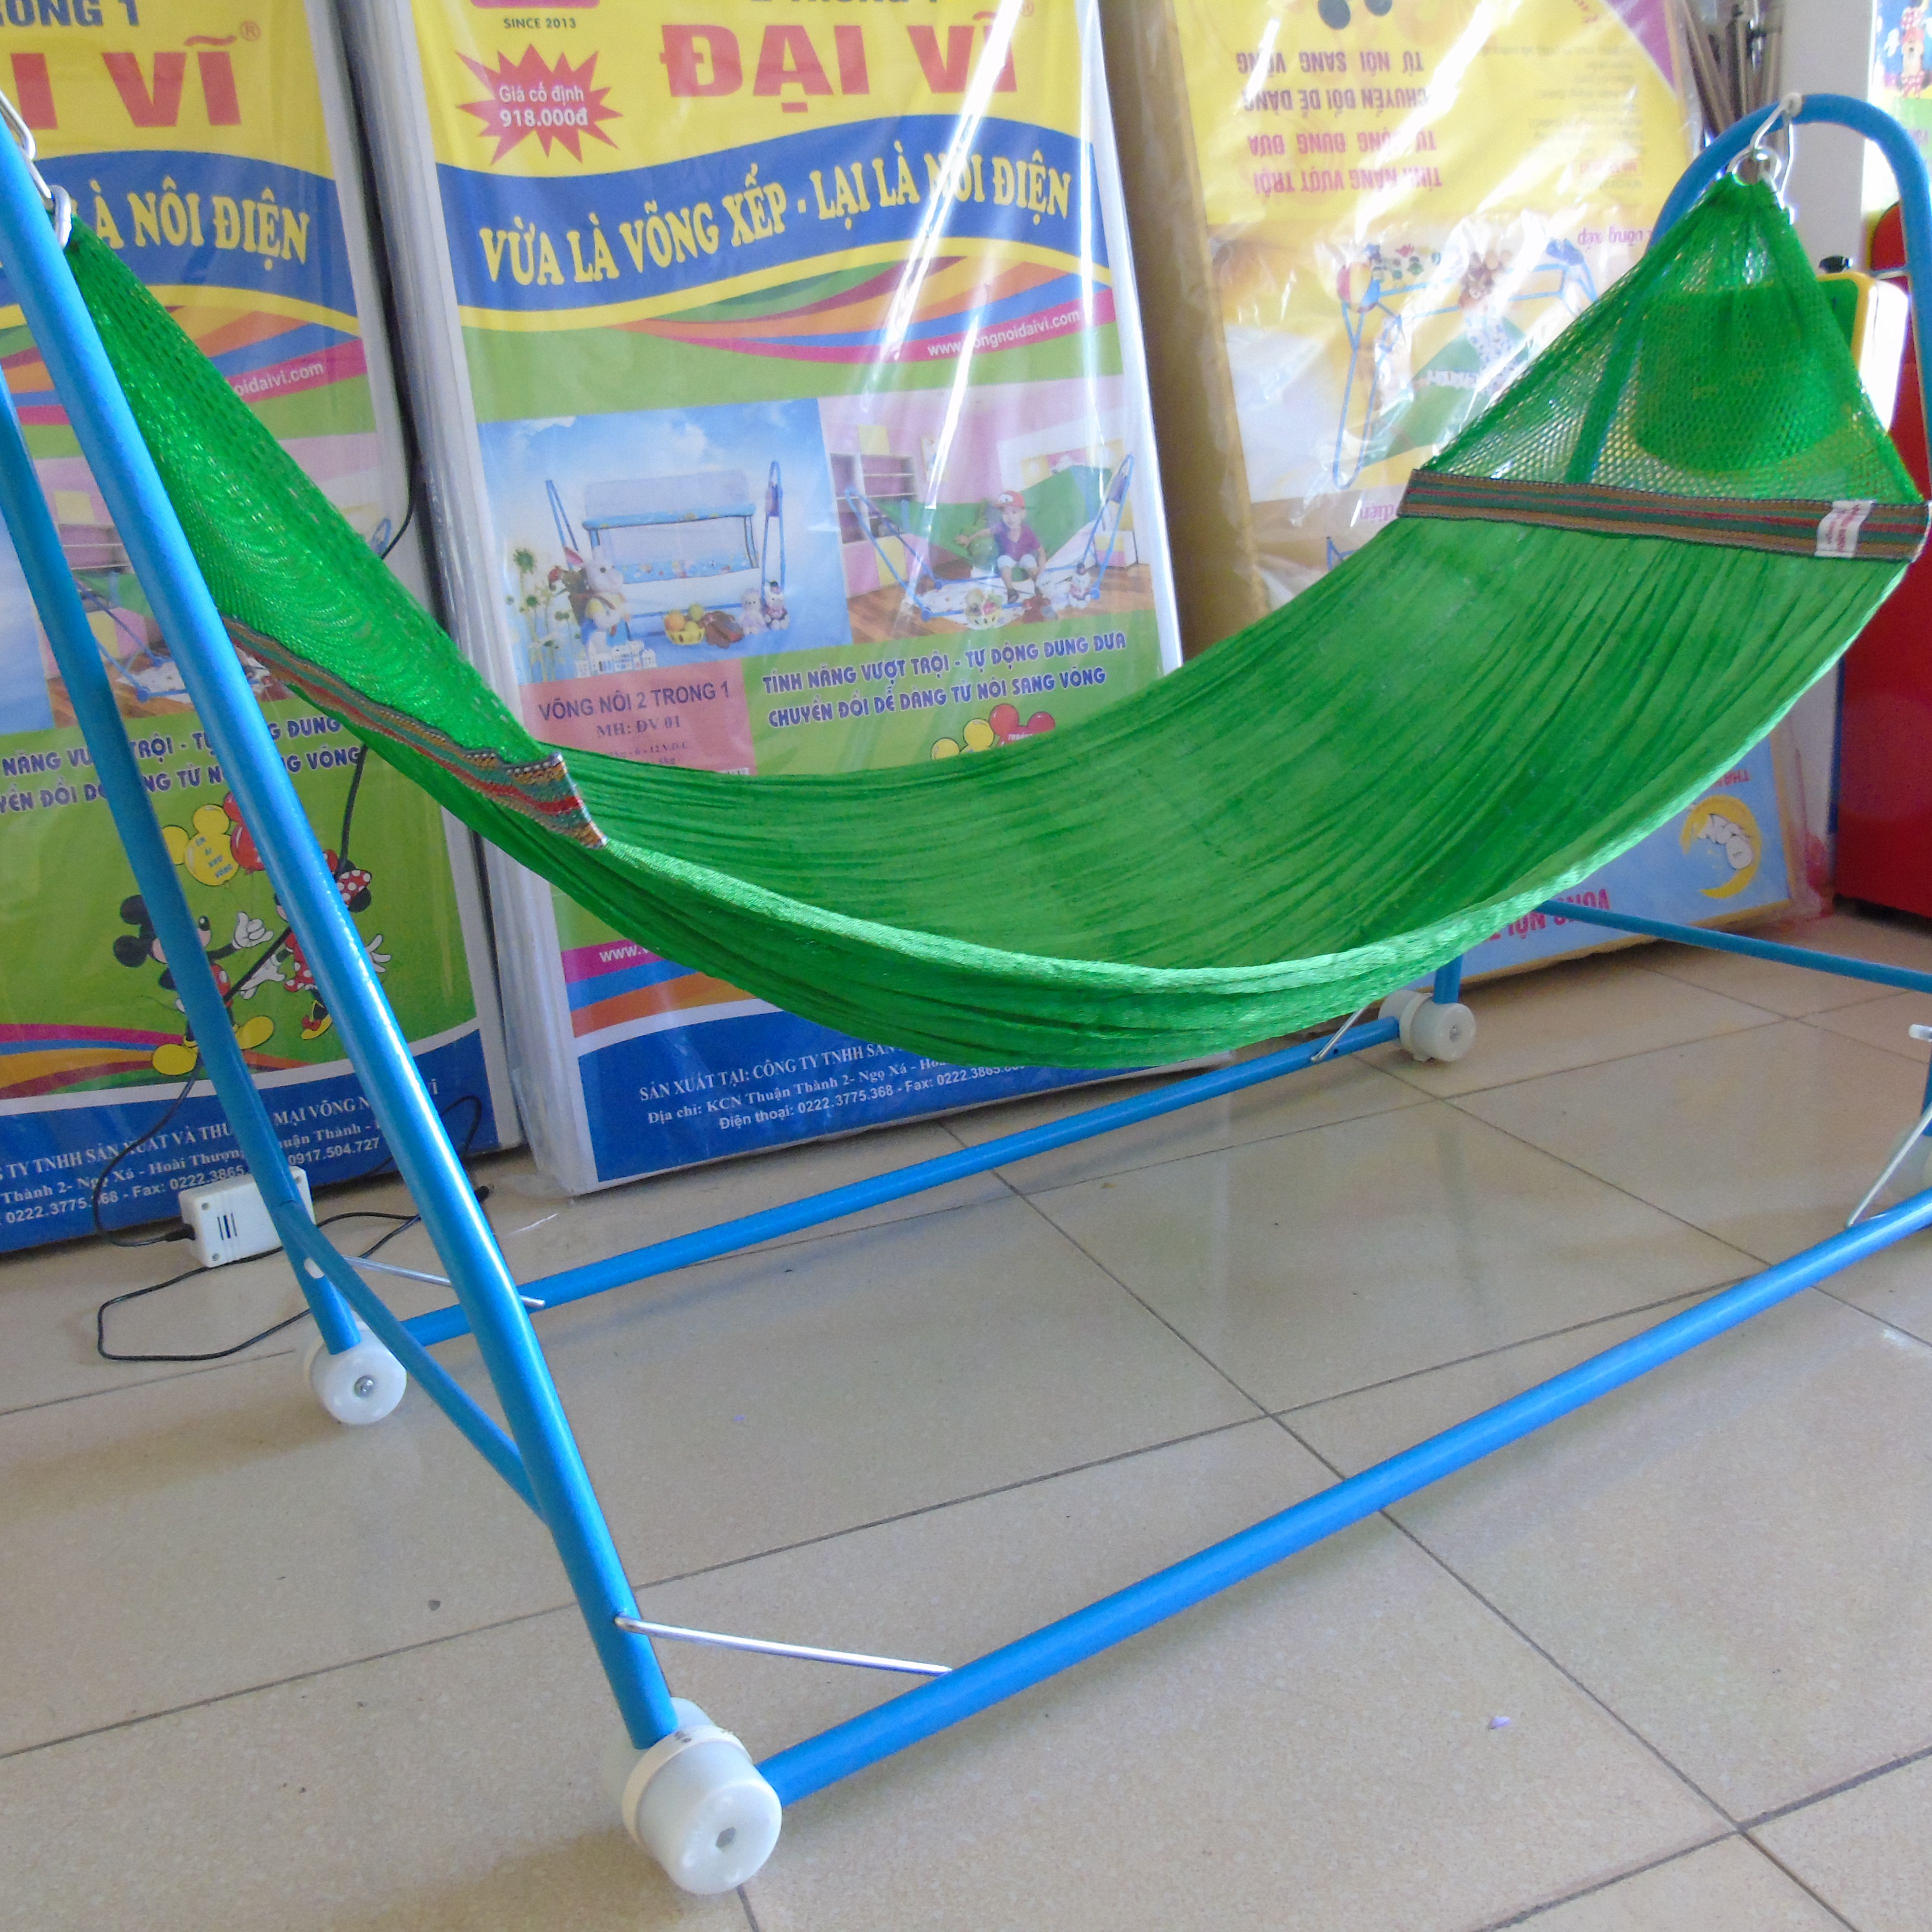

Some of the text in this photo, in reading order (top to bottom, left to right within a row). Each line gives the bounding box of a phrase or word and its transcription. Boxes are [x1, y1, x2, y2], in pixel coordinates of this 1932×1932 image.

[504, 18, 576, 28] SINCE 2013
[659, 24, 870, 114] ĐẠI
[1298, 51, 1348, 73] SANG
[101, 35, 242, 128] VĨ
[499, 82, 585, 106] Giá cố định
[500, 106, 588, 128] 918.000đ
[127, 175, 204, 248] NÔI
[210, 187, 310, 272] ĐIỆN
[478, 215, 566, 286] VỪA
[566, 211, 620, 284] LÀ
[618, 199, 720, 274] VÕNG
[722, 162, 787, 248] XẾP
[809, 162, 871, 230] LẠI
[872, 140, 920, 206] LÀ
[992, 148, 1070, 225] ĐIỆN
[762, 670, 803, 694] TÍNH
[807, 664, 857, 688] NĂNG
[860, 658, 906, 685] VƯỢT
[910, 650, 950, 679] TRỘI
[965, 648, 986, 673] TỰ
[990, 641, 1039, 670] ĐỘNG
[1043, 636, 1088, 658] ĐUNG
[1092, 632, 1126, 652] ĐƯA
[538, 681, 729, 721] VÕNG NÔI 2 TRONG 1
[768, 666, 1106, 728] CHUYỂN ĐỔI DỄ DÀNG TỪ NÔI SANG VÕNG
[288, 716, 342, 738] ĐUNG
[664, 716, 681, 728] 01
[2, 750, 62, 776] NĂNG
[306, 744, 362, 770] VÕNG
[40, 777, 78, 808] ĐỔI
[176, 763, 200, 788] TỪ
[752, 1059, 797, 1080] CÔNG
[799, 1054, 819, 1070] TY
[820, 1046, 864, 1066] TNHH
[308, 1098, 356, 1118] VÕNG
[706, 1096, 742, 1113] KCN
[745, 1087, 791, 1105] Thuận
[794, 1077, 838, 1095] Thành
[719, 1113, 752, 1130] Điện
[798, 1084, 894, 1114] 0222.3775.368
[904, 1078, 934, 1092] Fax:
[316, 1123, 362, 1141] Thành
[6, 1162, 32, 1178] TY
[32, 1151, 82, 1174] TNHH
[288, 1137, 380, 1166] 0917.504.727
[0, 1184, 54, 1205] Thành
[150, 1156, 186, 1176] Hoài
[6, 1191, 119, 1224] 0222.3775.68
[132, 1184, 166, 1199] Fax:
